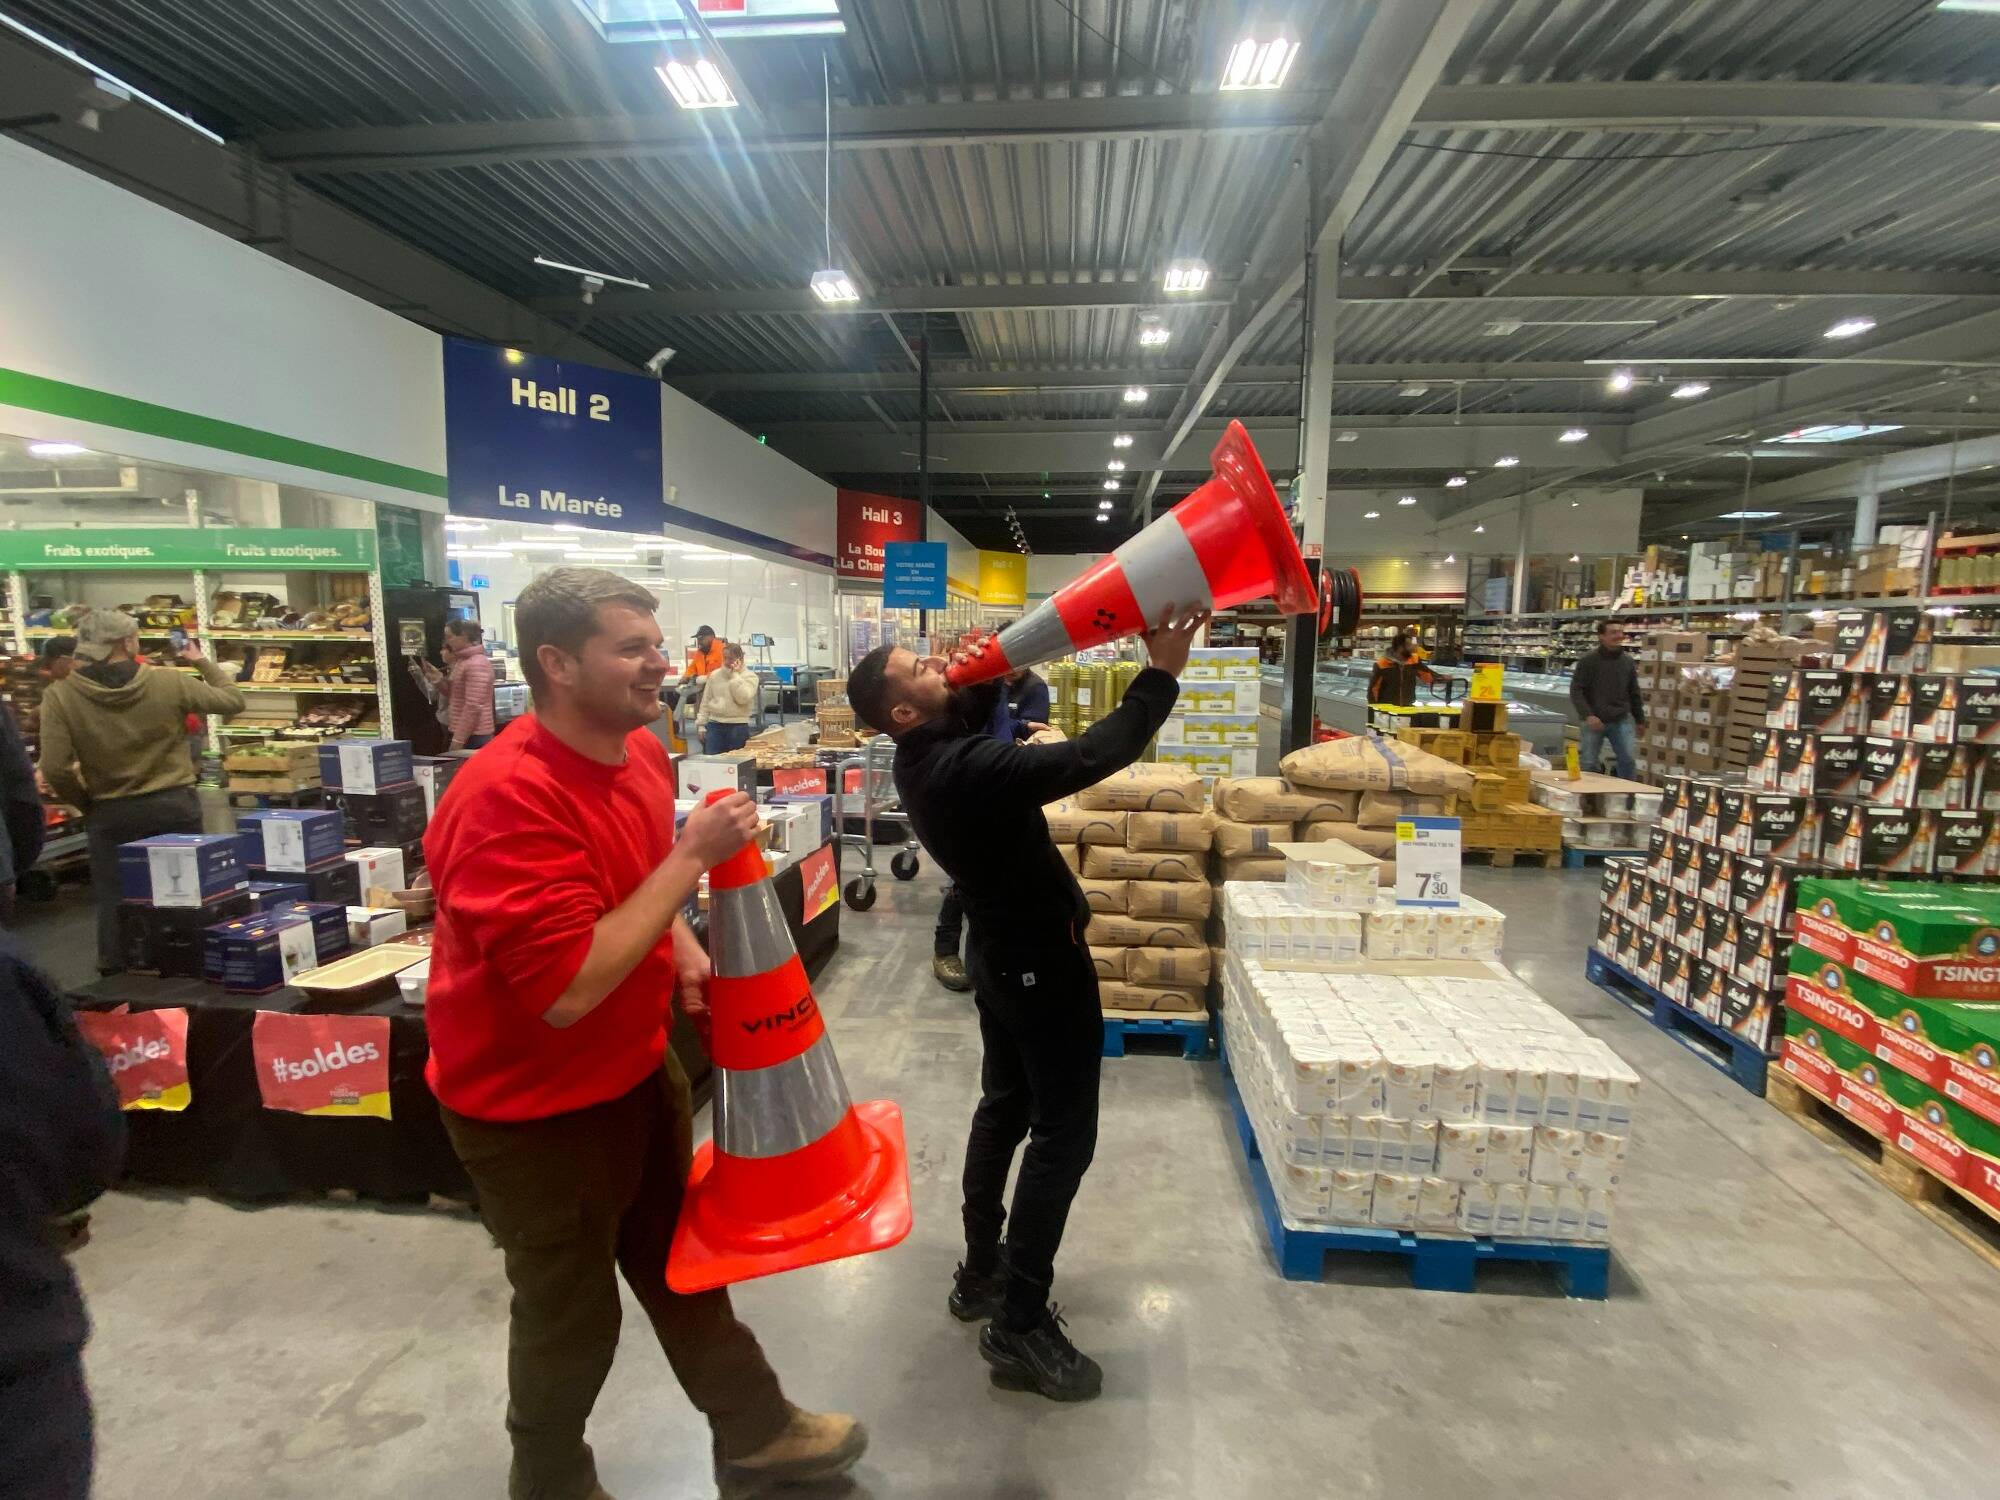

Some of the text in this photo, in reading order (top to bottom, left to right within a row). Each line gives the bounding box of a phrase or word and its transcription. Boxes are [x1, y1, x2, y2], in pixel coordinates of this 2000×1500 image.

[511, 377, 610, 422] Hall 2
[498, 485, 623, 518] La Marée
[862, 506, 903, 526] Hall 3
[44, 544, 155, 560] Fruits exotiques.
[226, 543, 342, 560] Fruits exotiques.
[848, 542, 885, 558] La Bou
[840, 557, 885, 572] La Char
[1965, 692, 2000, 706] Asah
[782, 777, 821, 795] #soldes
[1415, 872, 1432, 898] 7
[1432, 882, 1448, 895] 30
[1799, 915, 1848, 943] TSINGTAO
[1856, 938, 1910, 969] TSINGTAO
[1795, 982, 1866, 1030] TSINGTAO
[1879, 1025, 1937, 1062] TSINGTAO
[272, 1040, 380, 1083] #soldes
[1901, 1113, 1962, 1158] TSINGTAO
